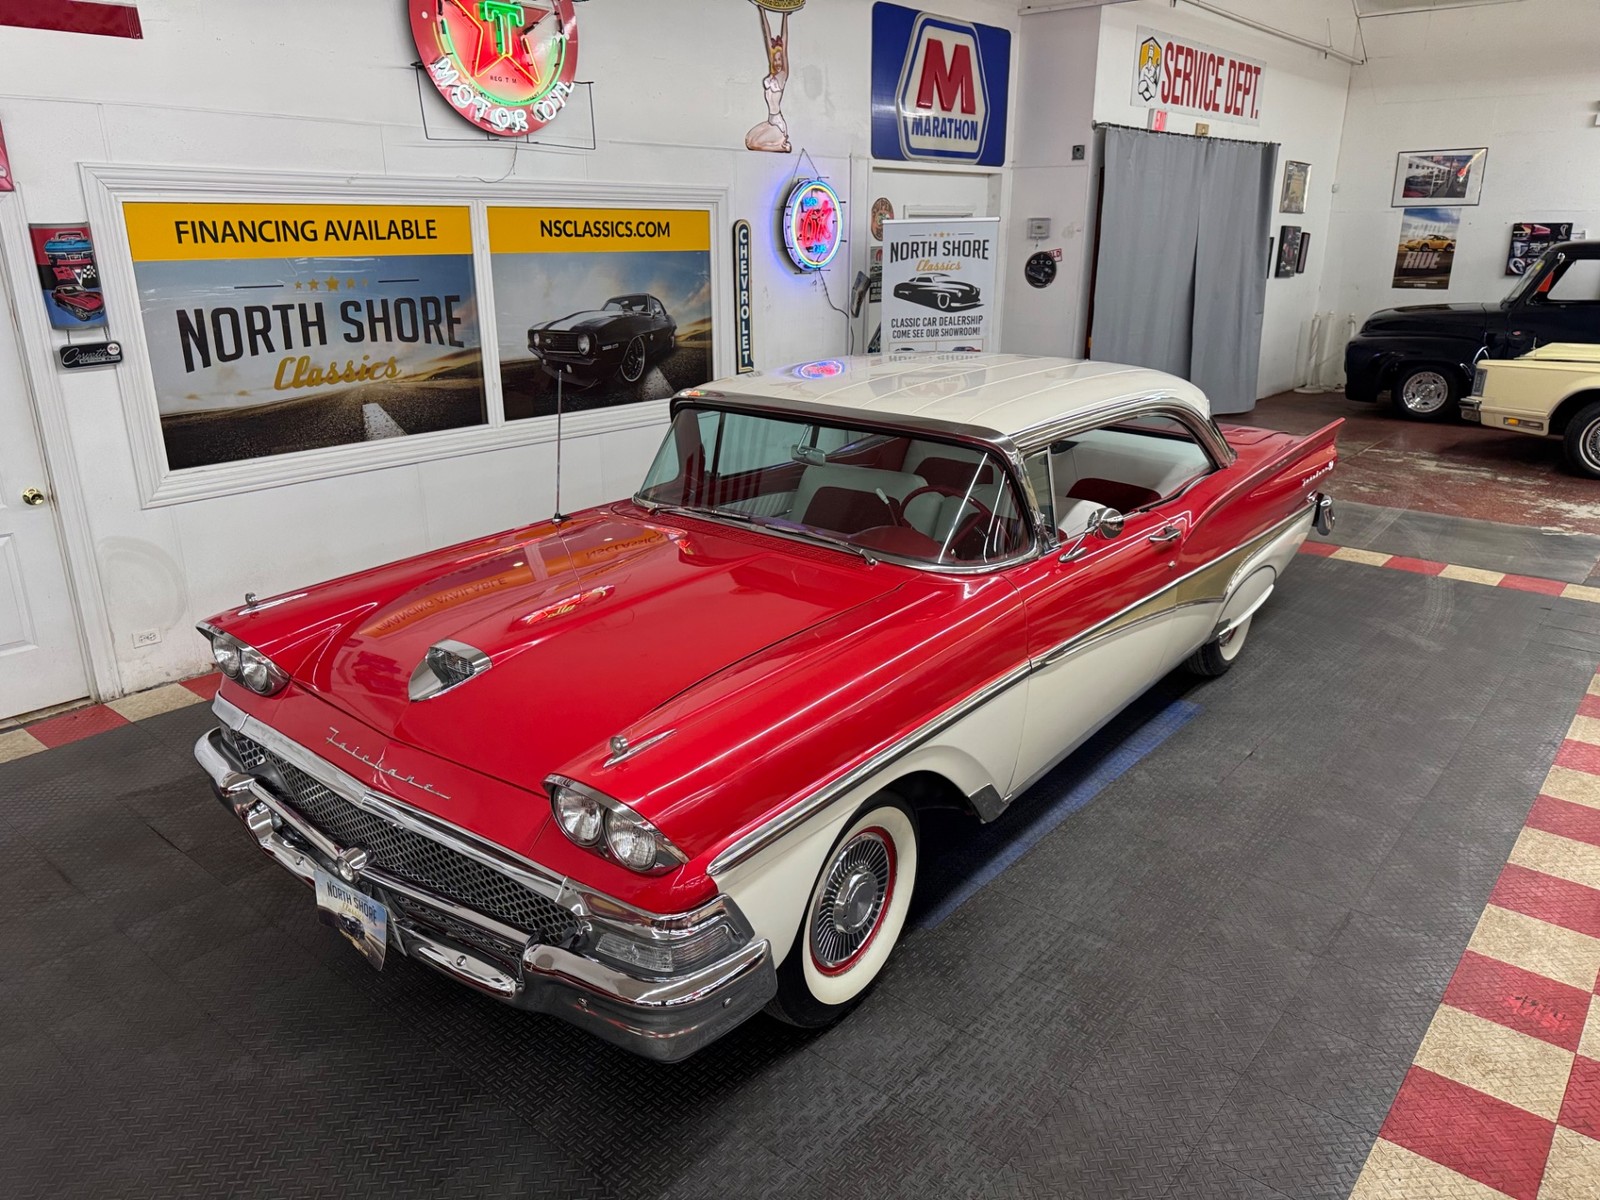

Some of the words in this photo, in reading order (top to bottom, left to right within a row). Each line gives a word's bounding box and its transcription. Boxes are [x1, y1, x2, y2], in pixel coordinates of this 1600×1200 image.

[916, 38, 976, 115] M
[1161, 41, 1225, 112] SERVICE
[1224, 59, 1261, 119] DEPT.
[429, 57, 529, 131] MOTOR
[532, 81, 575, 121] OIL
[911, 116, 978, 141] MARATHON
[174, 219, 318, 244] FINANCING
[324, 219, 438, 241] AVAILABLE
[540, 220, 671, 238] NSCLASSICS.COM
[890, 240, 937, 263] NORTH
[942, 239, 990, 260] SHORE
[1402, 251, 1440, 269] RIDE
[915, 259, 961, 272] Classics
[739, 229, 751, 364] CHEVROLET
[176, 302, 327, 374] NORTH
[339, 294, 466, 349] SHORE
[891, 317, 920, 328] CLASSIC
[922, 317, 937, 327] CAR
[939, 315, 983, 326] DEALERSHIP
[892, 330, 910, 339] COME
[912, 329, 924, 338] SEE
[926, 328, 939, 337] OUR
[940, 327, 980, 337] SHOWROOM!
[273, 354, 403, 391] Classics
[327, 880, 352, 906] NORTH
[353, 897, 377, 926] SHORE
